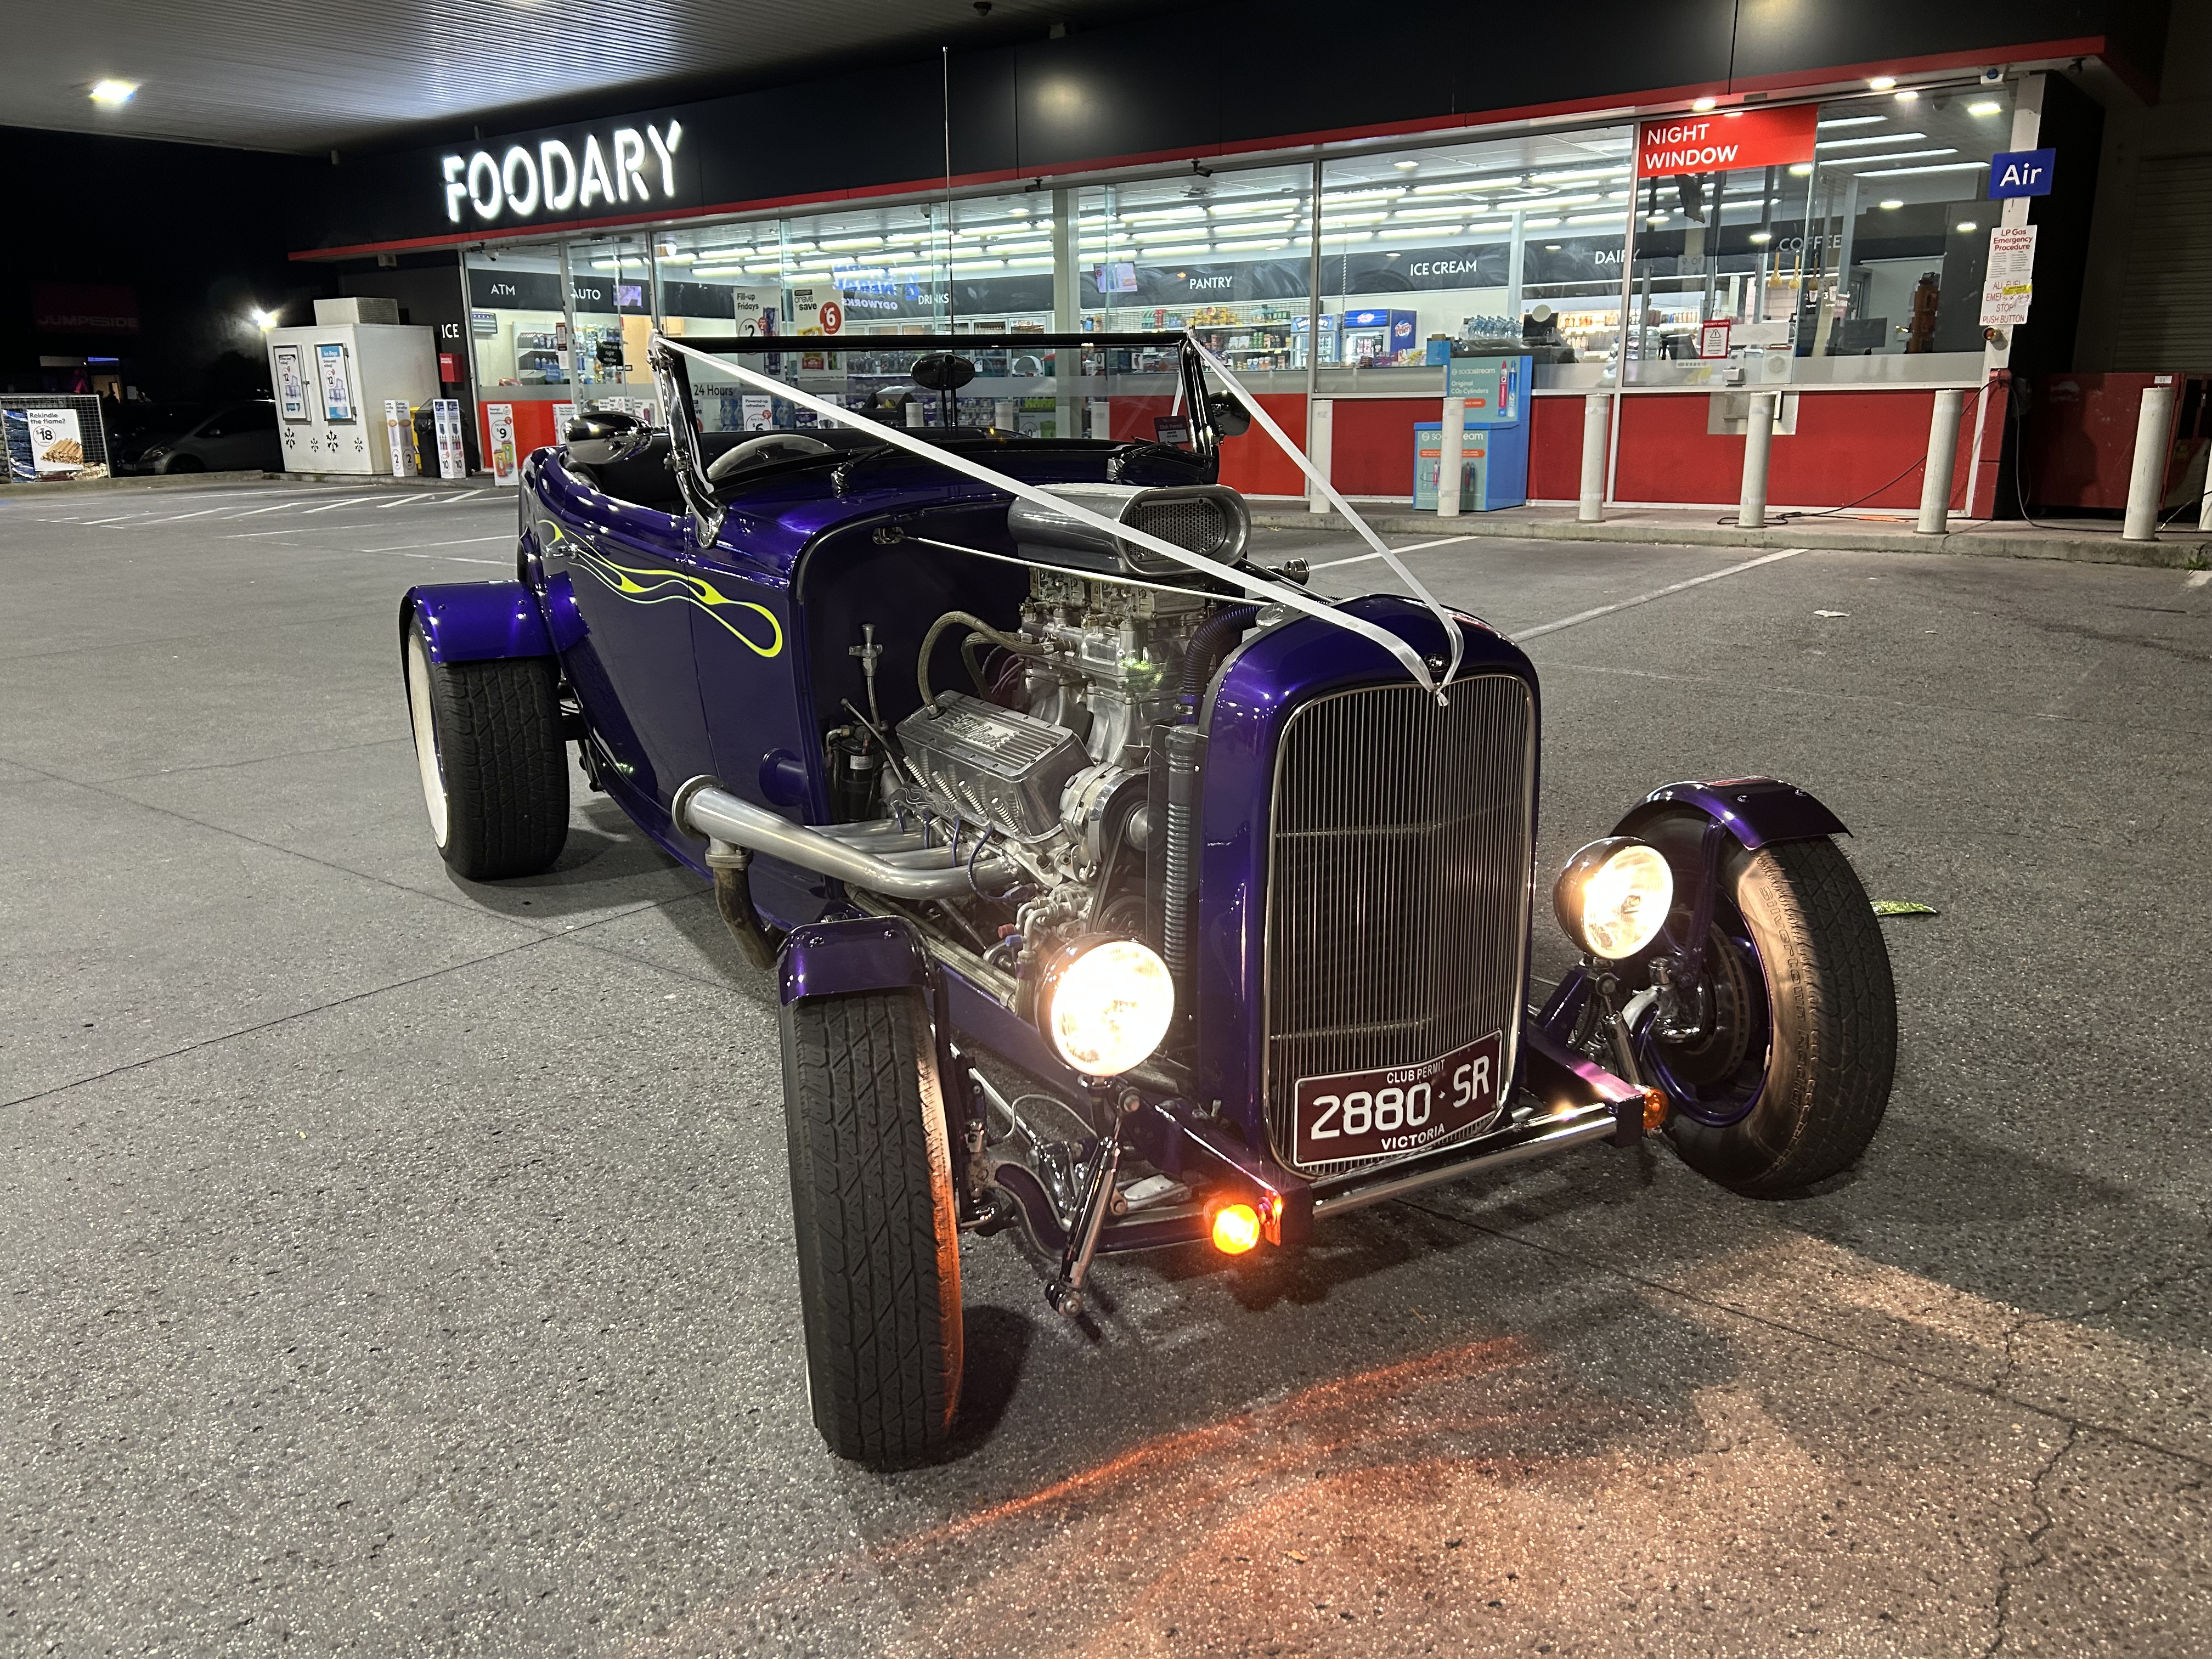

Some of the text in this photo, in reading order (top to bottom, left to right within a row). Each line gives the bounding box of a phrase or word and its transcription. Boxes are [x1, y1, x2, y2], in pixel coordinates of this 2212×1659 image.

[1647, 123, 1710, 145] NIGHT
[1645, 144, 1738, 170] WINDOW
[442, 120, 681, 223] FOODARY
[1999, 162, 2042, 187] Air
[1993, 236, 2033, 245] Emergency
[1994, 243, 2030, 251] Procedure
[1410, 259, 1477, 276] ICE CREAM
[1189, 276, 1233, 290] PANTRY
[490, 284, 516, 296] ATM
[572, 289, 601, 301] AUTO
[737, 292, 755, 301] Fill-up
[918, 293, 950, 305] DRINKS
[737, 302, 759, 311] Fridays
[799, 303, 817, 311] save
[1996, 303, 2014, 313] STOP
[1982, 314, 2025, 324] PUSH BUTTON
[441, 323, 460, 339] ICE
[693, 384, 733, 396] 24 Hours
[1759, 885, 1806, 1022] Silvertown
[1386, 1059, 1446, 1084] CLUB PERMIT
[1311, 1055, 1490, 1140] 2880 SR
[1381, 1122, 1445, 1150] VICTORIA
